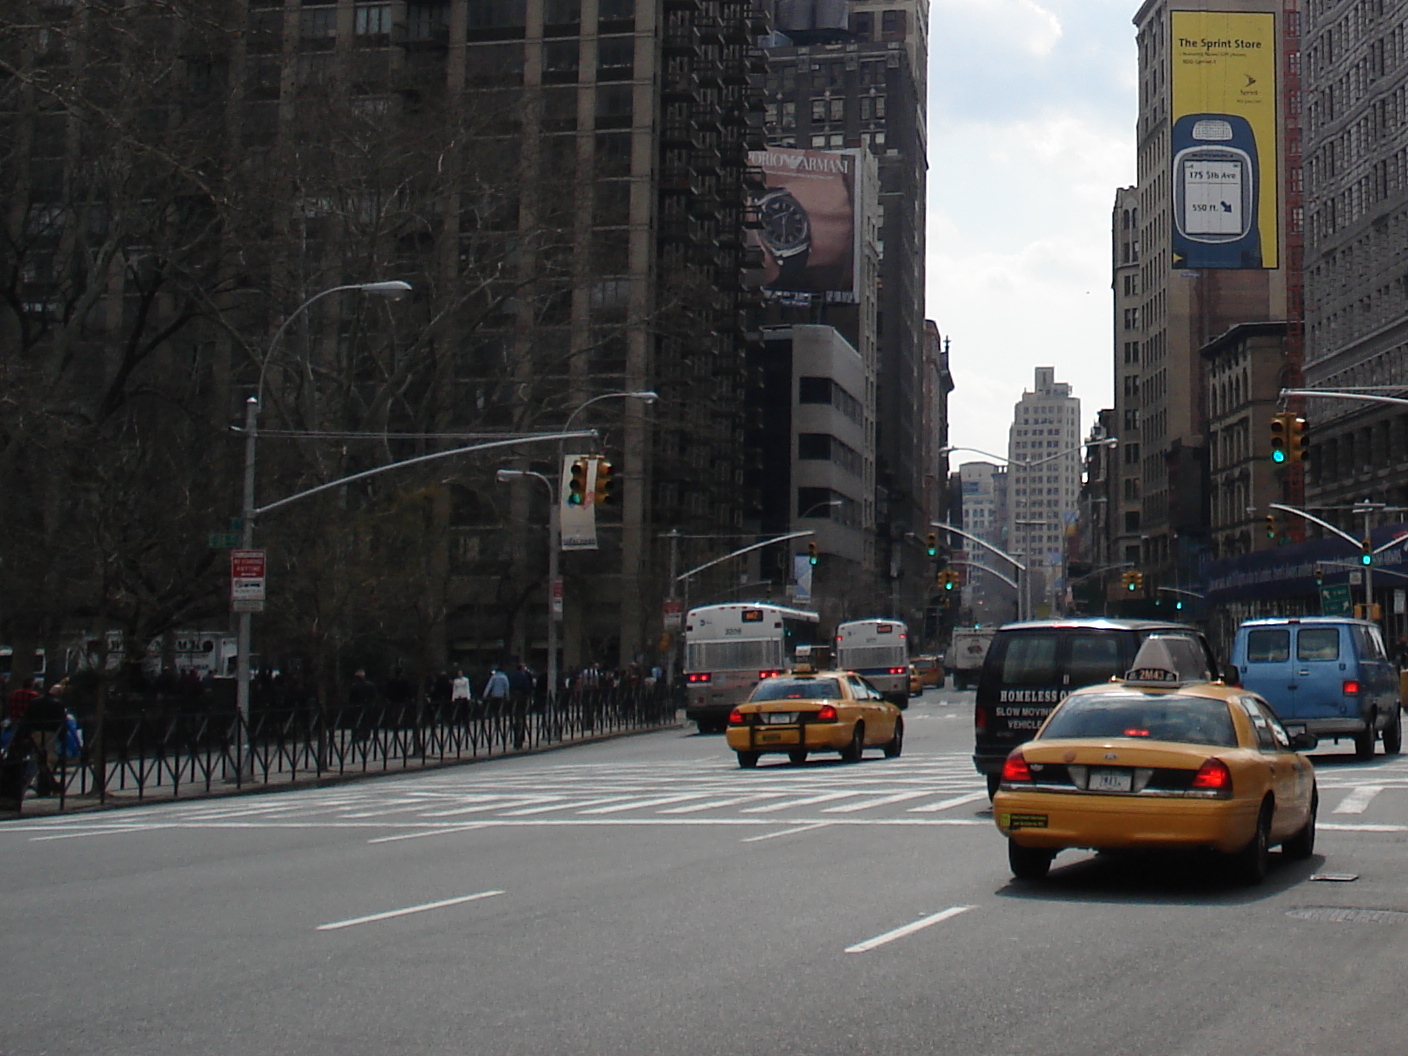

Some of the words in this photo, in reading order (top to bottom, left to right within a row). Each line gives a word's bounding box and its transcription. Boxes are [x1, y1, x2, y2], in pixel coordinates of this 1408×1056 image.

[1179, 38, 1198, 48] The
[1201, 38, 1232, 51] Sprint
[1234, 39, 1262, 49] Store
[799, 156, 849, 174] ARMANI
[1189, 171, 1203, 180] 175
[1221, 171, 1237, 180] Ave
[1192, 204, 1207, 212] 550
[1140, 669, 1165, 680] 2M43
[1000, 690, 1057, 702] HOMELESS
[996, 707, 1020, 717] SLOW
[1008, 719, 1042, 730] VEHICLE
